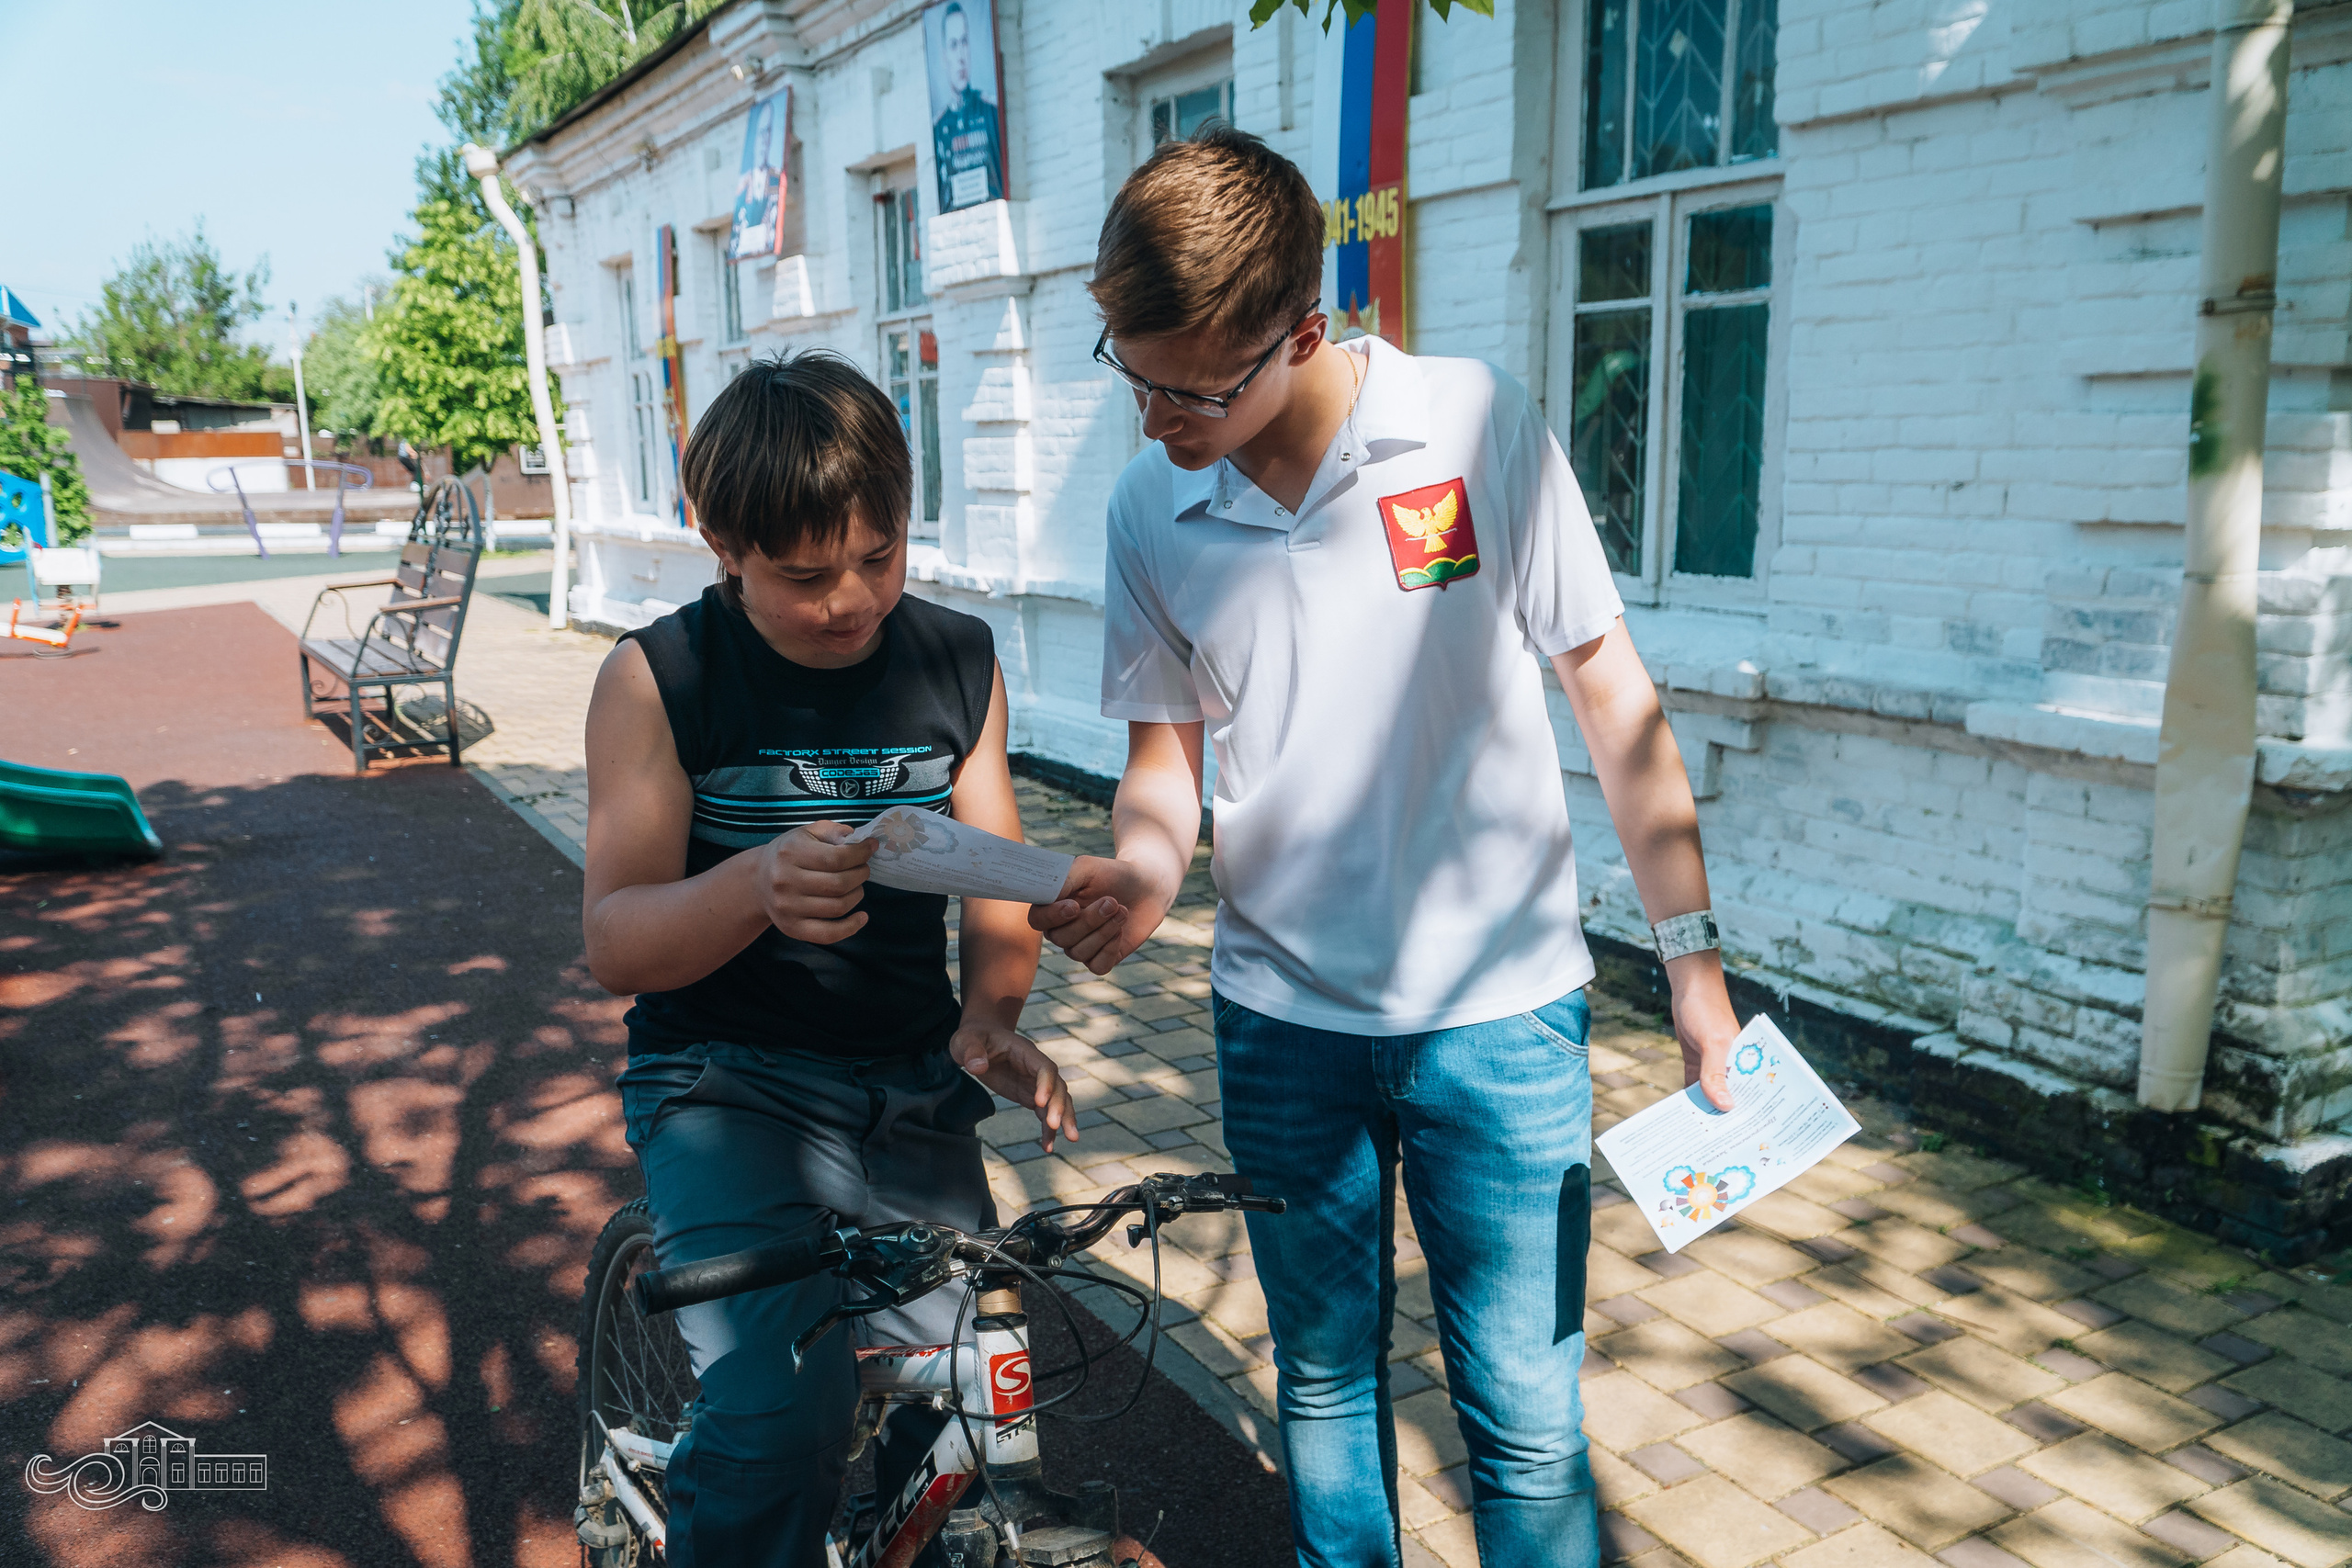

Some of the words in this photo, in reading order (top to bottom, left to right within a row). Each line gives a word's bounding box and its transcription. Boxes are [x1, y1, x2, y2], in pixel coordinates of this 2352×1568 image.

[1321, 186, 1399, 249] 941-1945
[818, 757, 847, 766] Danger
[849, 756, 878, 766] Design
